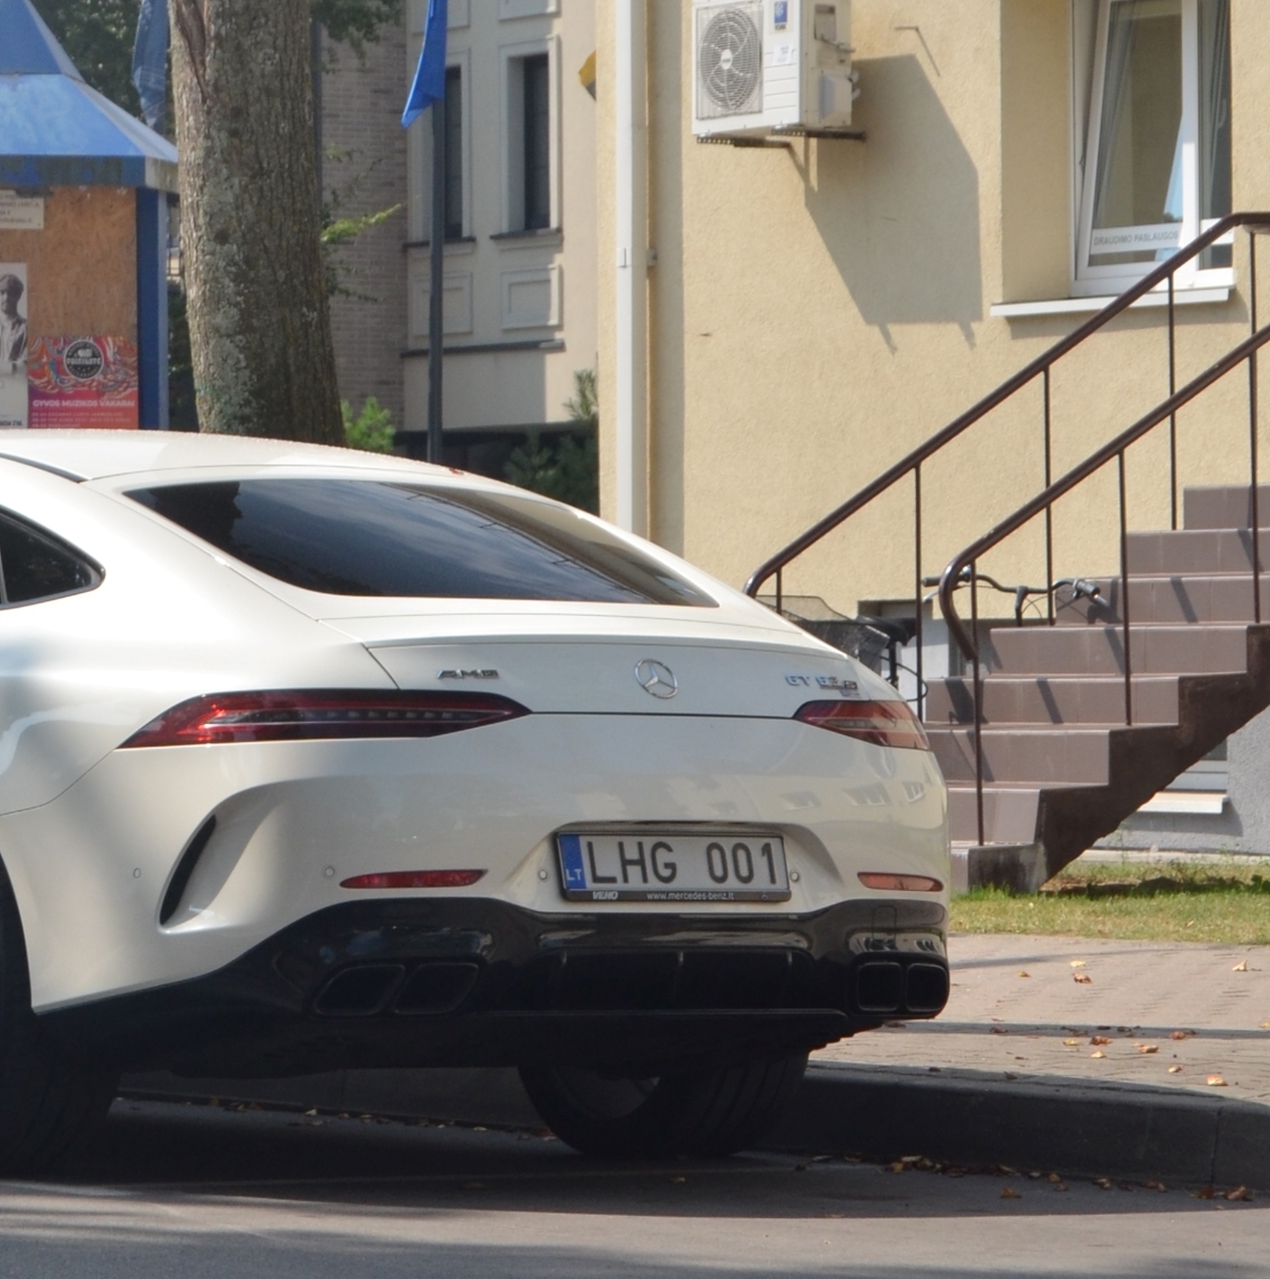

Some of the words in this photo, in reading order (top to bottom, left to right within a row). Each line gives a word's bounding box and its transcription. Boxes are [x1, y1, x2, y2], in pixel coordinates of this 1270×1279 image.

[1093, 235, 1133, 245] DRAUDIMO
[1133, 231, 1178, 242] PASLAUGOS
[32, 399, 60, 407] GYVOS
[62, 399, 98, 407] MUZIKOS
[99, 399, 135, 407] VAKARAI
[437, 669, 499, 679] AMG
[587, 841, 677, 884] LHG
[706, 842, 777, 885] 001
[566, 868, 582, 881] LT
[646, 892, 735, 901] www.mercedes-benz.lt
